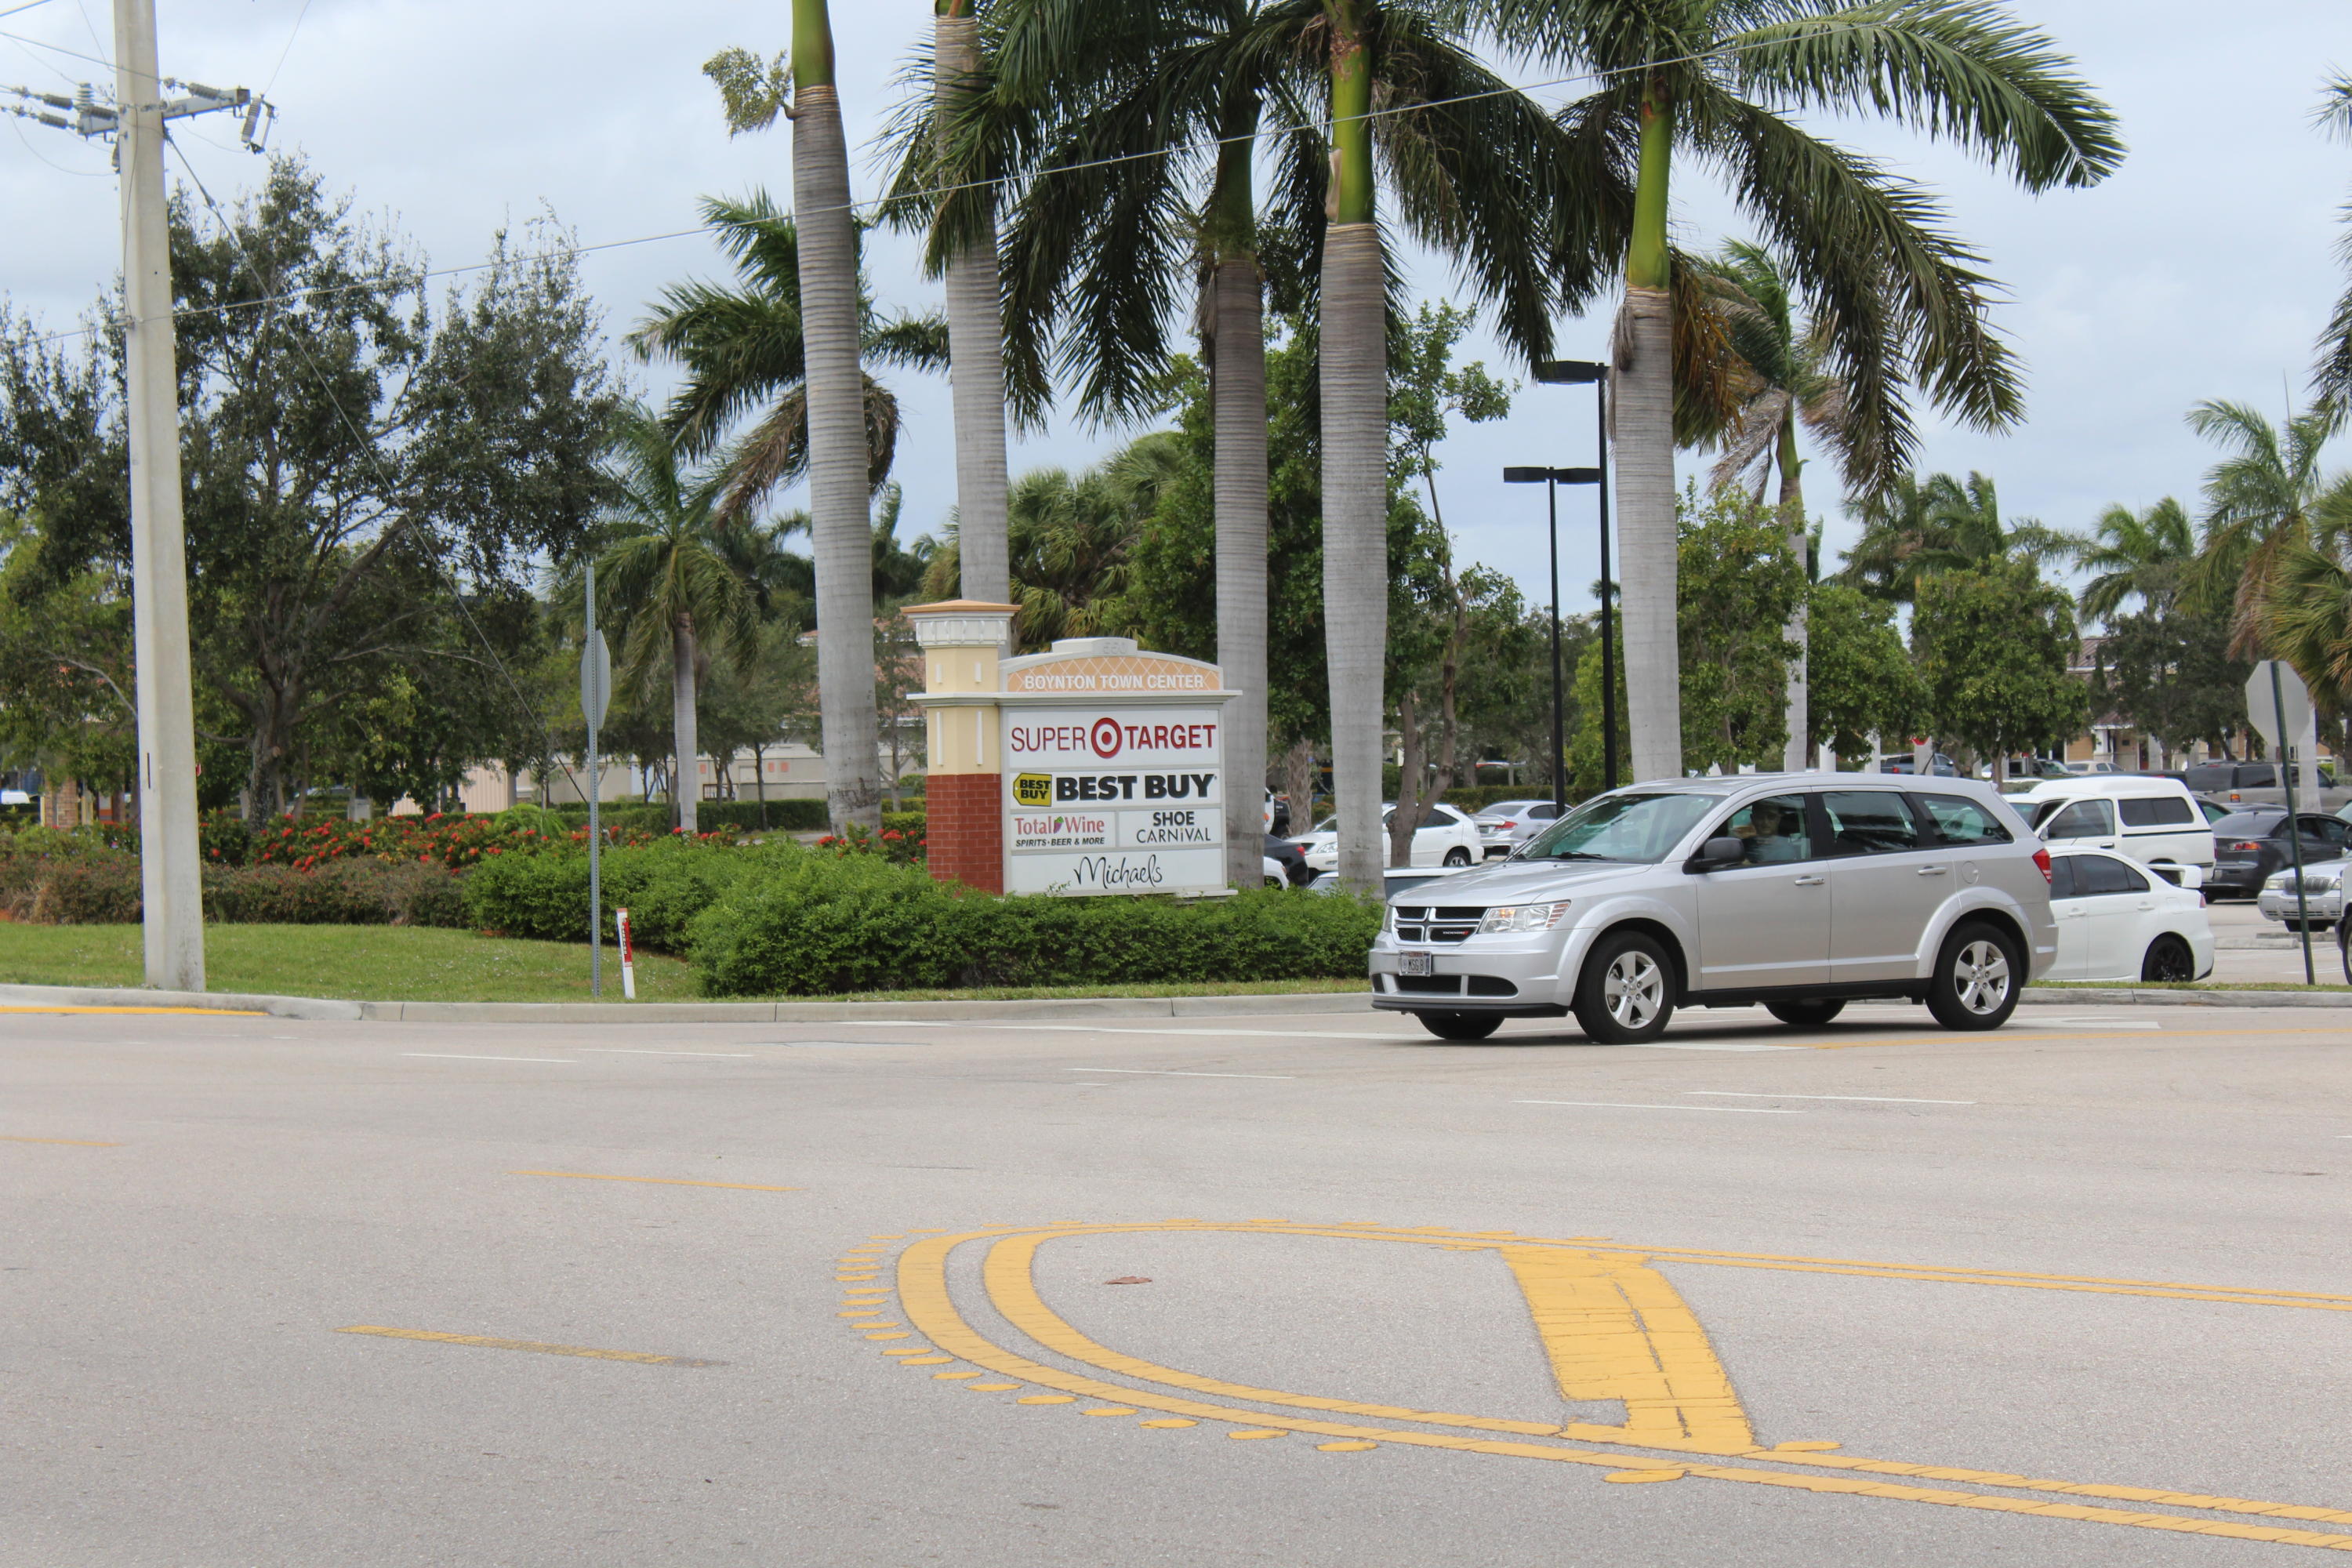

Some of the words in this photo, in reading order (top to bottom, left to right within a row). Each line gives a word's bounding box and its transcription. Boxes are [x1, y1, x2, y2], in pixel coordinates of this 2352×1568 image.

[1025, 675, 1095, 690] BOYNTON
[1100, 675, 1142, 688] TOWN
[1147, 674, 1204, 688] CENTER
[1011, 727, 1087, 752] SUPER
[1124, 724, 1217, 750] TARGET
[1020, 779, 1051, 789] BEST
[1056, 775, 1137, 801] BEST
[1145, 773, 1215, 799] BUY
[1021, 789, 1047, 799] BUY
[1014, 816, 1052, 835] Total
[1065, 815, 1105, 834] Wine
[1152, 811, 1195, 827] SHOE
[1073, 854, 1163, 889] Michaels
